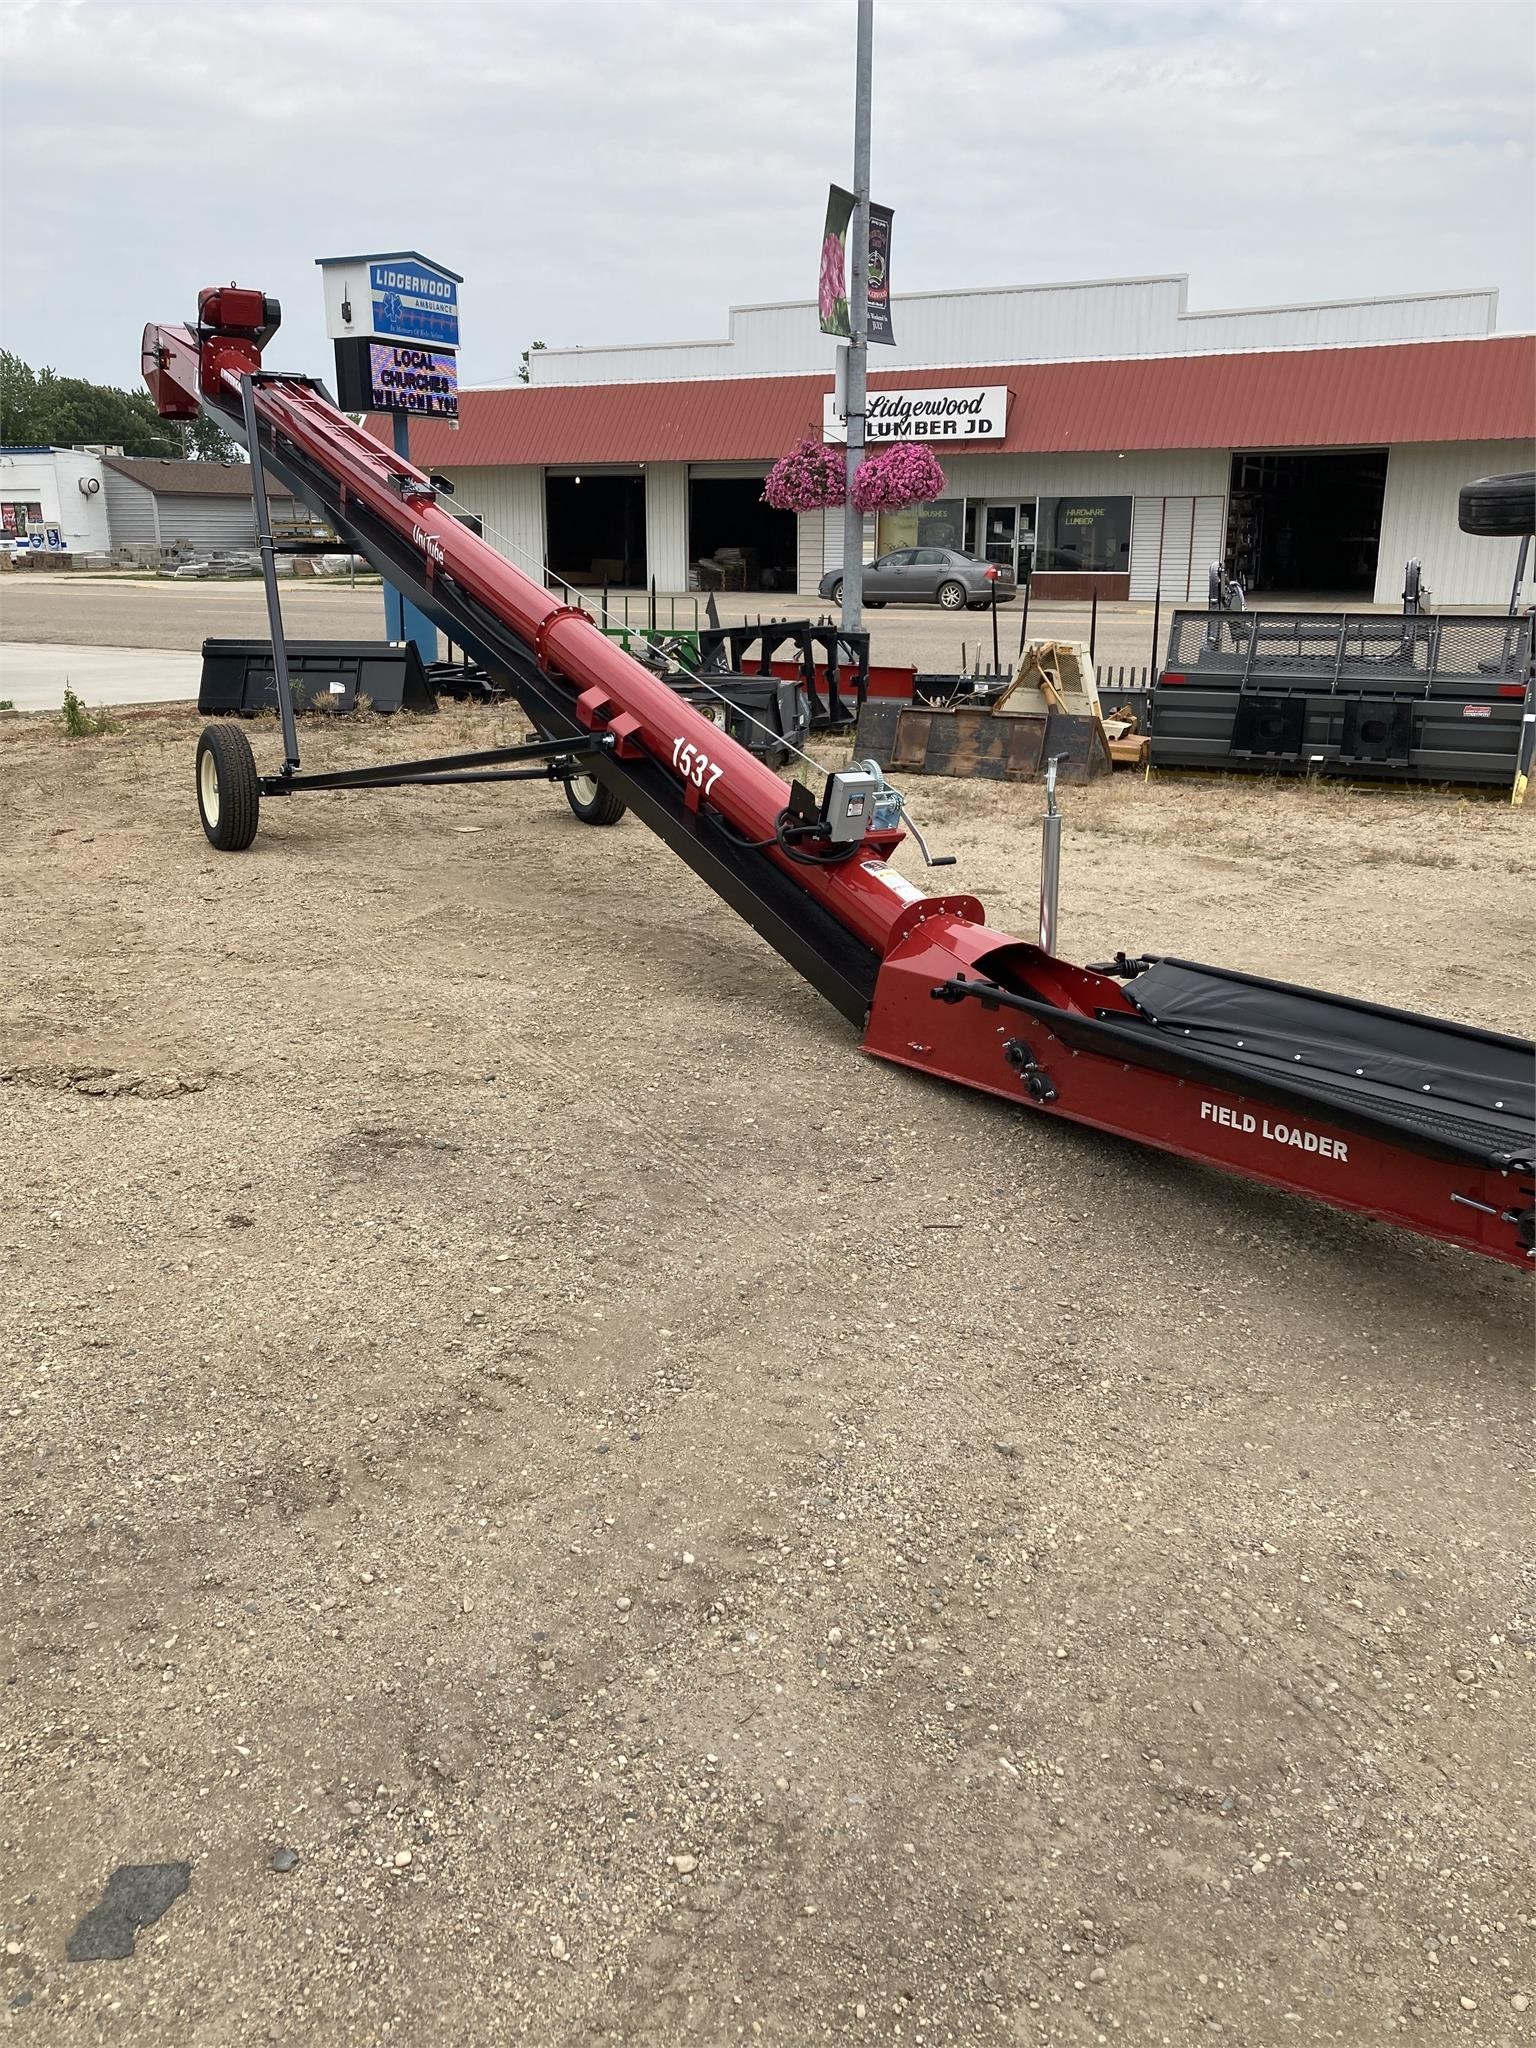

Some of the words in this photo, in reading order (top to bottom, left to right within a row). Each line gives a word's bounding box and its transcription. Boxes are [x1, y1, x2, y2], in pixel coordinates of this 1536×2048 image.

[376, 269, 451, 298] LIDGERWOOD
[415, 300, 453, 313] AMBULANCE
[393, 349, 436, 371] LOCAL
[381, 370, 450, 393] CHURCHES
[373, 389, 434, 410] WELCOME
[436, 396, 458, 412] YOU
[866, 392, 986, 425] Lidgerwood
[867, 421, 957, 437] LUMBER
[964, 419, 993, 435] JD
[1065, 517, 1094, 525] LUMBER
[1066, 508, 1105, 516] HARDWARE
[412, 524, 445, 565] UniTube
[673, 736, 725, 796] 1537
[1200, 1101, 1257, 1133] FIELD
[1262, 1119, 1349, 1163] LOADER
